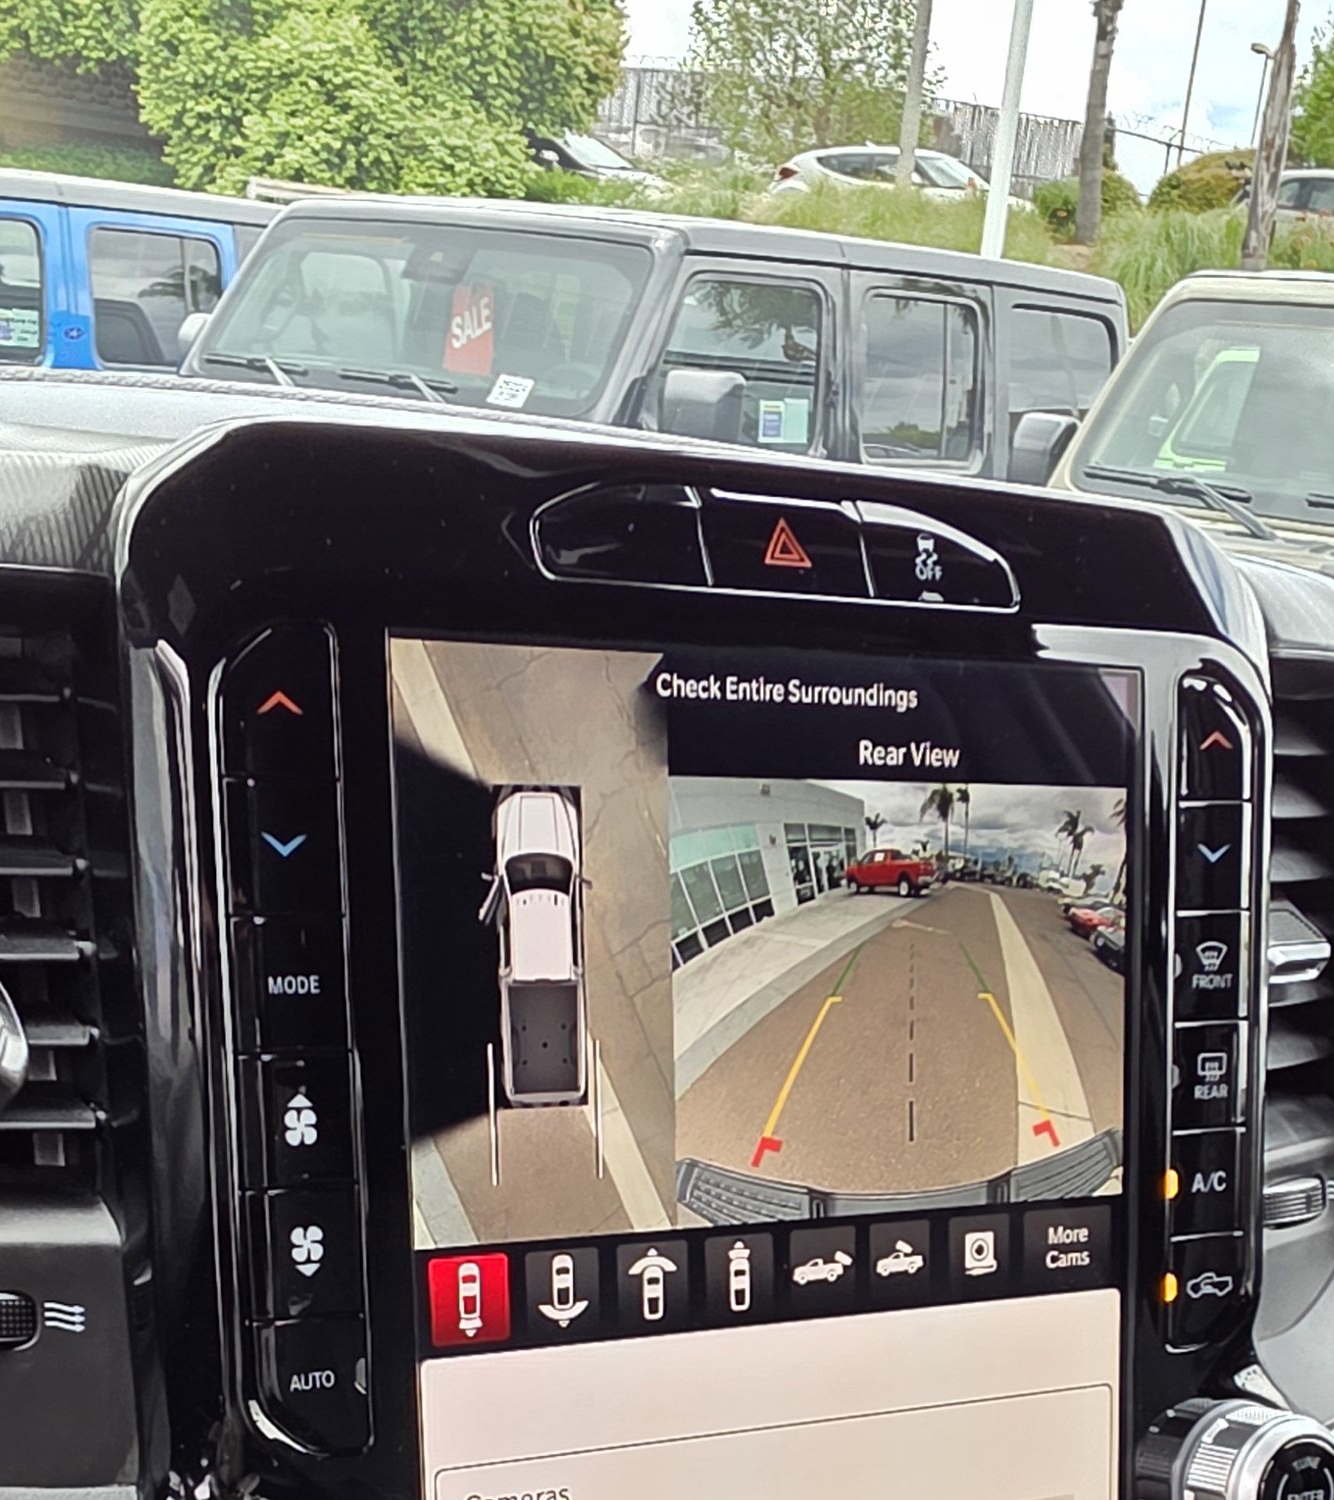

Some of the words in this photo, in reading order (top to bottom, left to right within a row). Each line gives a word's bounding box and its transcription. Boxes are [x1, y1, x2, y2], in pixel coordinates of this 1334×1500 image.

[451, 296, 493, 349] SALE
[914, 565, 943, 581] OFF
[655, 673, 722, 699] Check
[725, 676, 785, 703] Entire
[788, 679, 919, 713] Surroundings
[858, 739, 907, 767] Rear
[910, 742, 960, 768] View
[267, 975, 321, 994] MODE
[1192, 974, 1233, 990] FRONT
[1194, 1084, 1229, 1100] REAR
[1191, 1170, 1227, 1193] A/C
[1047, 1226, 1089, 1245] More
[1046, 1251, 1090, 1269] Cams
[289, 1370, 335, 1392] AUTO
